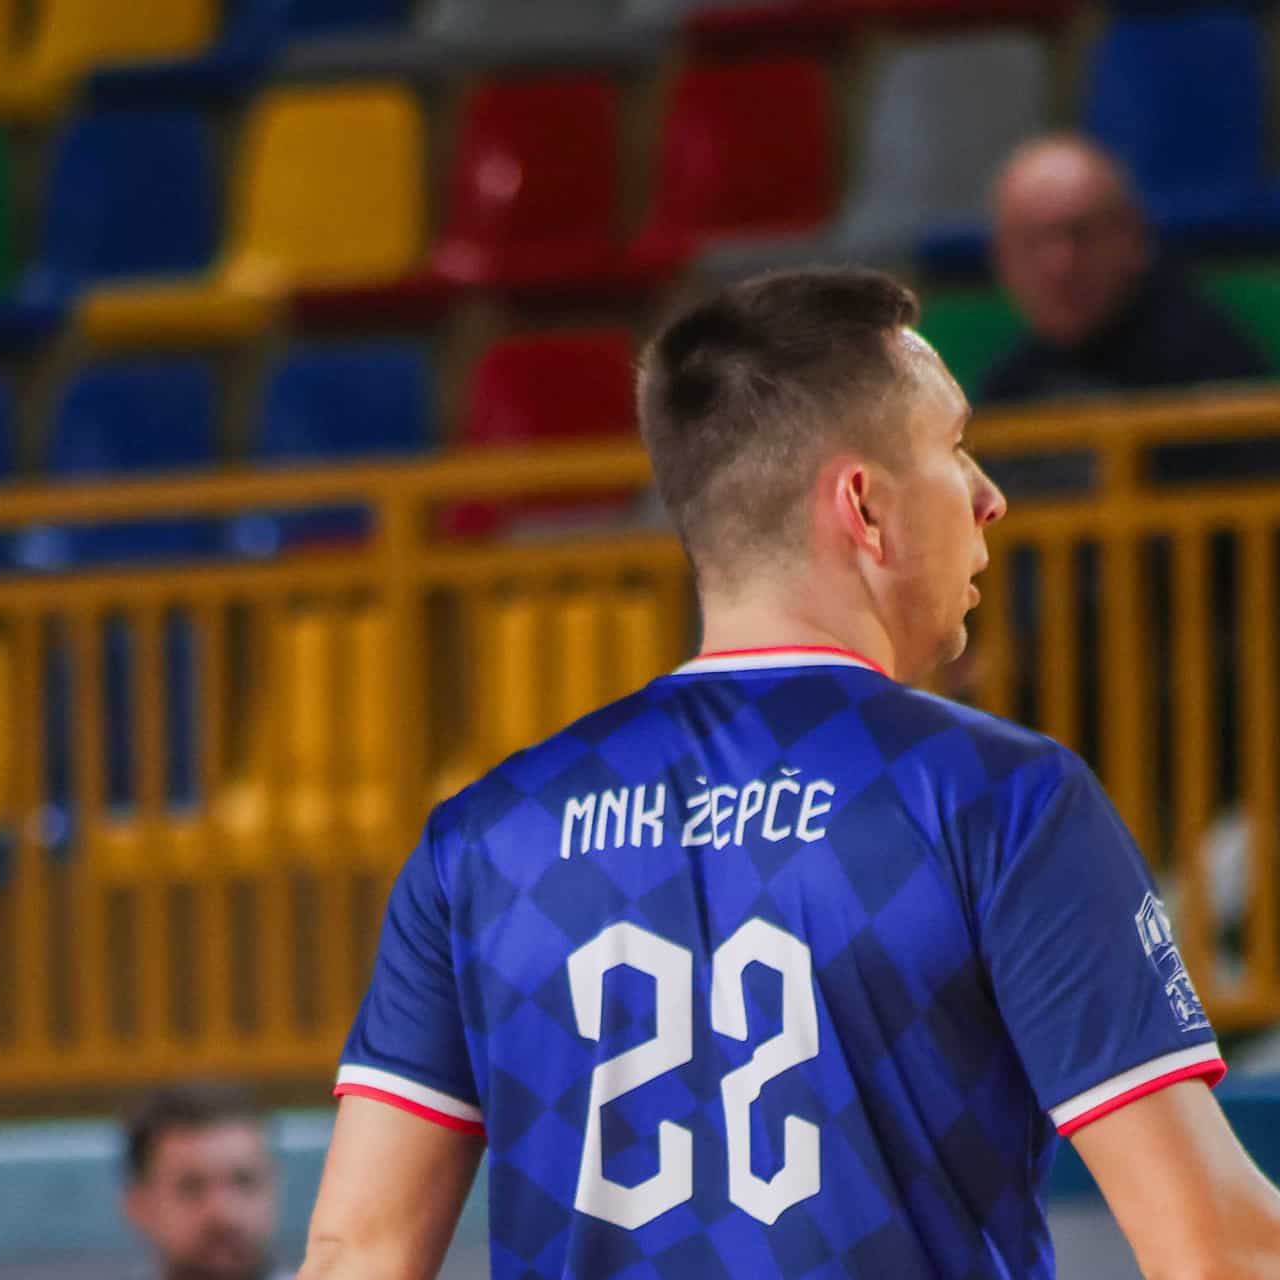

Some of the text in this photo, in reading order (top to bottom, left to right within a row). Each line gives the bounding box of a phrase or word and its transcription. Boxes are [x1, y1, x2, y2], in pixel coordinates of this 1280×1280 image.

[559, 768, 836, 860] MNK ŽEPČE
[567, 916, 821, 1231] 22
